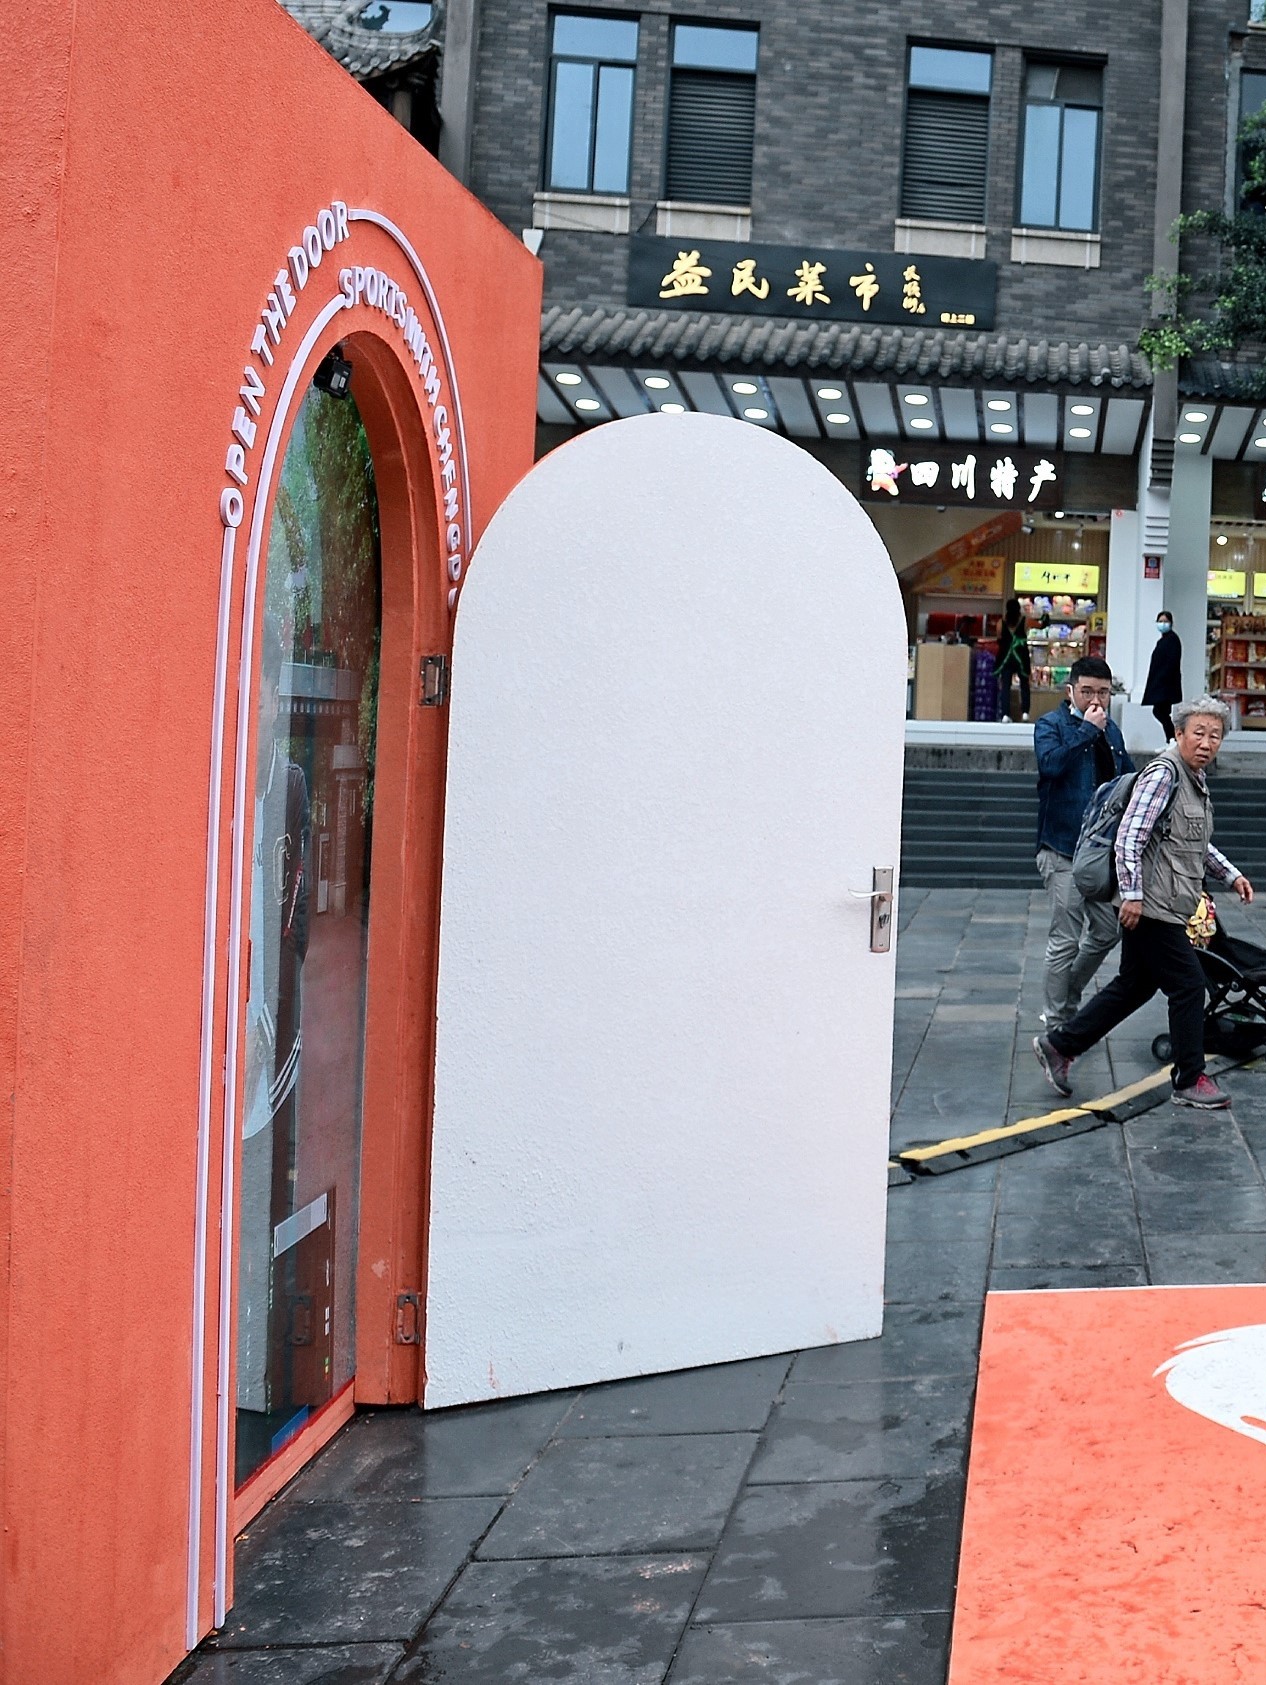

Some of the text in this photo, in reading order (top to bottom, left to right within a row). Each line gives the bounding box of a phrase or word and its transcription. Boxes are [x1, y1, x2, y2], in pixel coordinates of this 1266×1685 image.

[338, 266, 408, 328] SPORTS
[659, 250, 881, 311] 益民菜市
[220, 200, 350, 528] OPEN THE DOOR
[910, 454, 1057, 502] 四川特产
